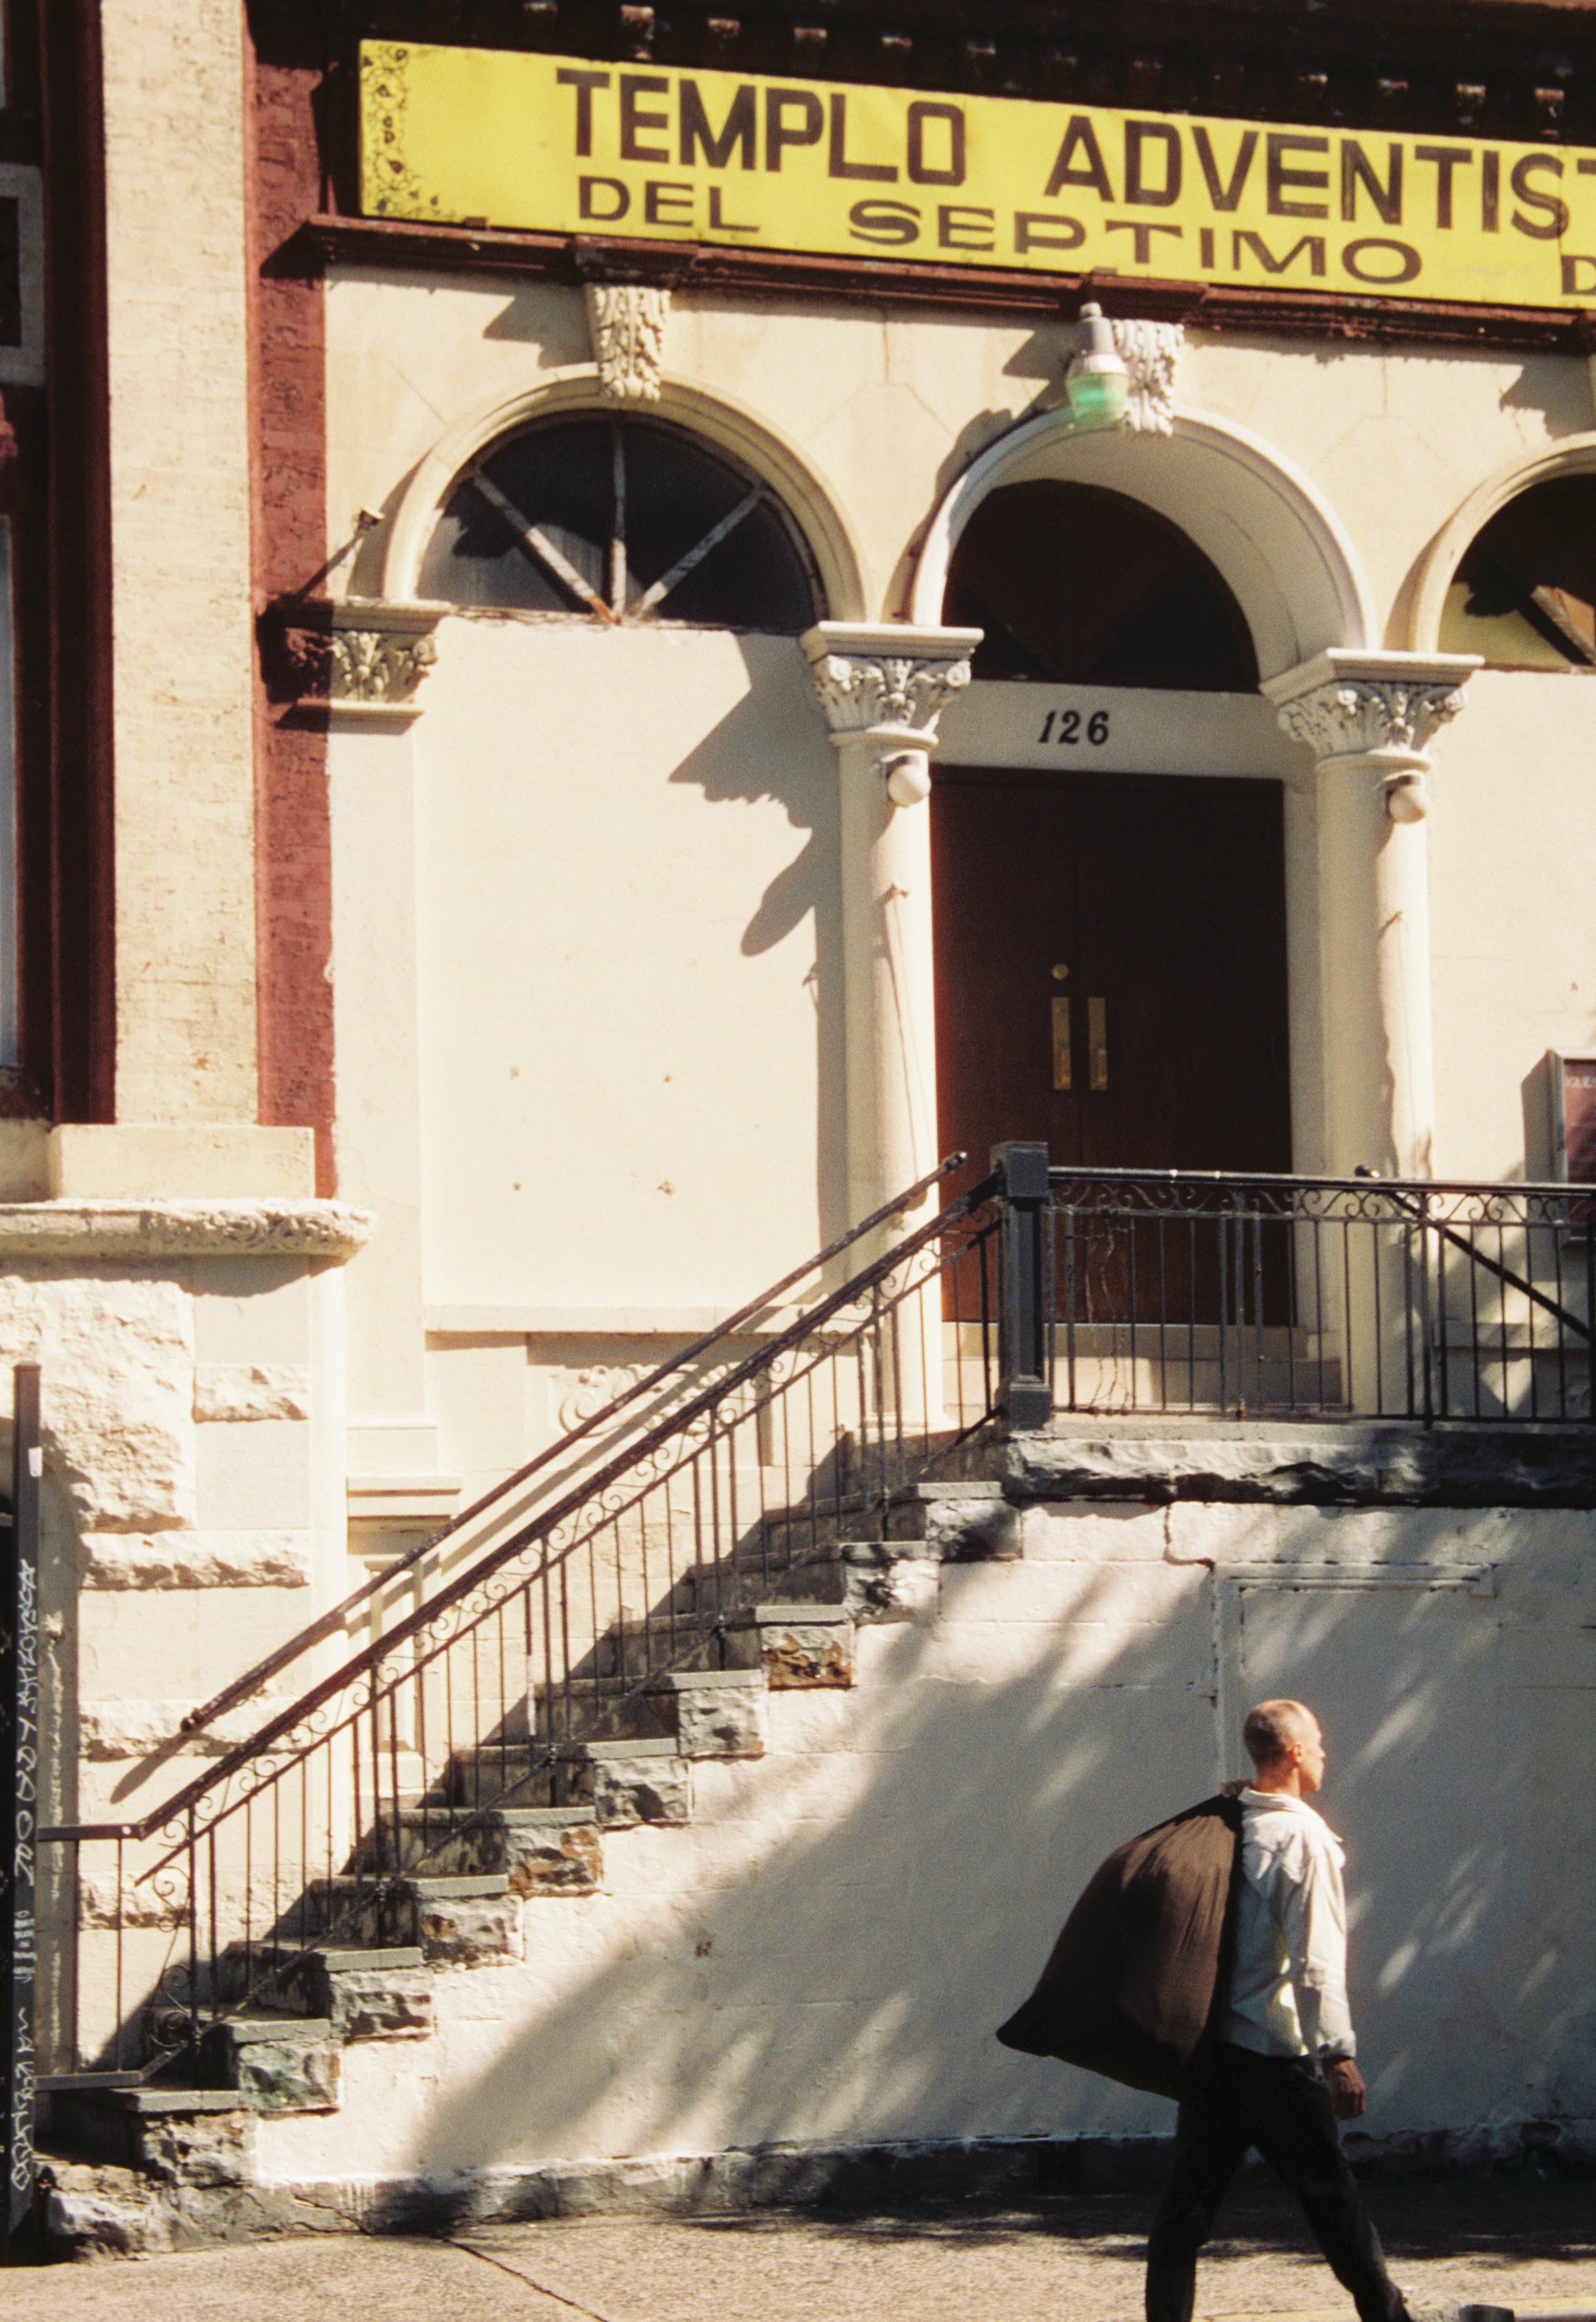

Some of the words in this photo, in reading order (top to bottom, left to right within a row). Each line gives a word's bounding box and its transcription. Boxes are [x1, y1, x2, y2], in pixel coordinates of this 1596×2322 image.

[557, 68, 965, 186] TEMPLO
[578, 176, 760, 232] DEL
[849, 200, 1422, 285] SEPTIMO
[1038, 711, 1109, 745] 126
